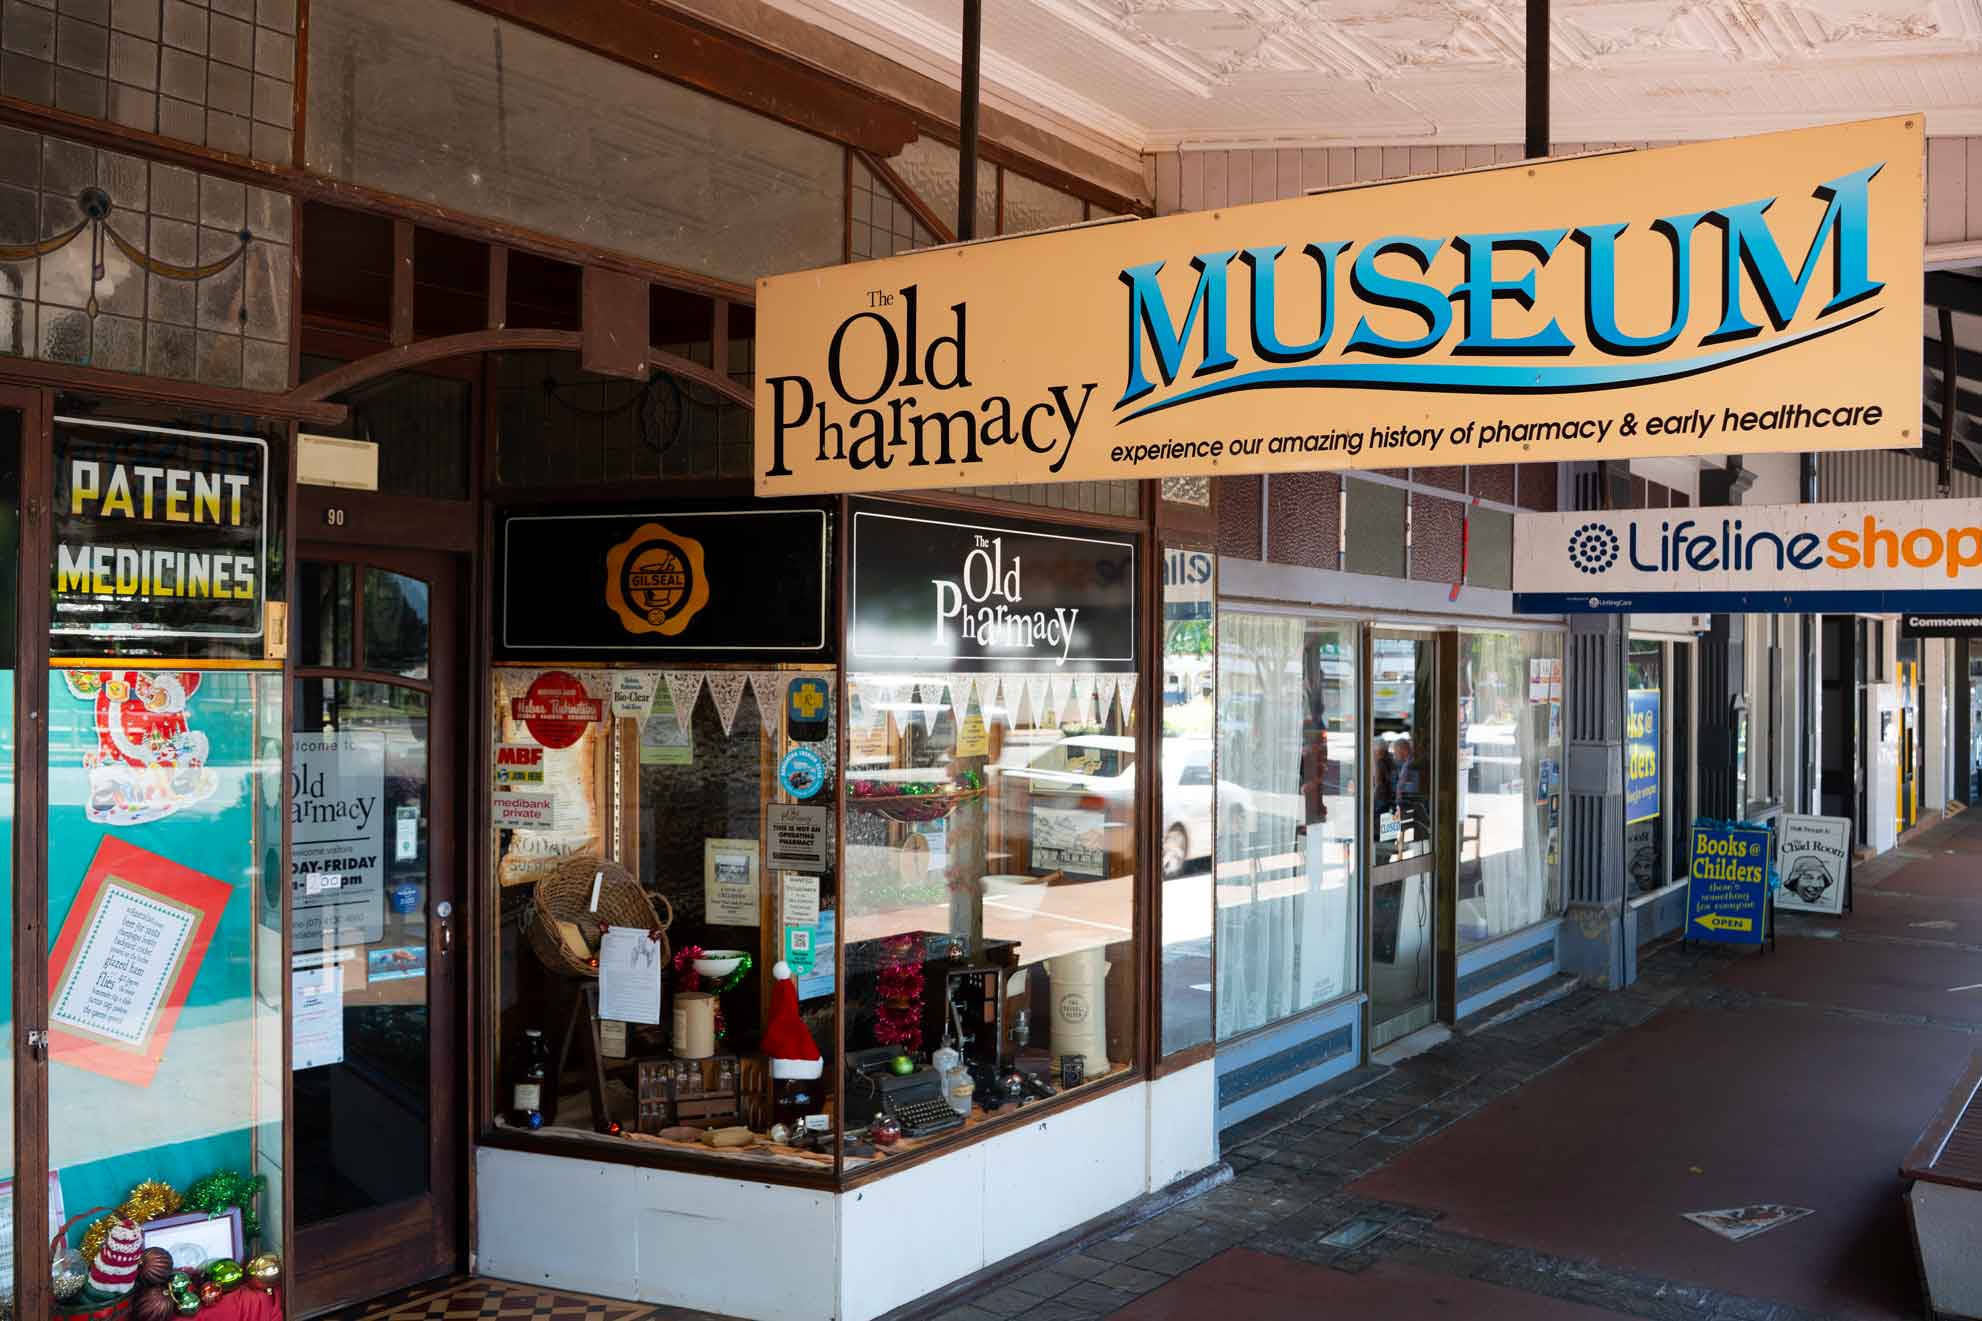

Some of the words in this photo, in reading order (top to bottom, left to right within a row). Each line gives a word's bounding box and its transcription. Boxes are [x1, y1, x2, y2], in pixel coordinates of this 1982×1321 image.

[867, 290, 894, 307] The
[1113, 162, 1886, 411] MUSEUM
[828, 284, 972, 404] Old
[765, 375, 1098, 477] Pharmacy
[1111, 438, 1222, 465] experience
[1229, 434, 1264, 456] our
[1268, 429, 1363, 456] amazing
[1369, 424, 1445, 452] history
[1450, 420, 1476, 446] of
[1479, 418, 1613, 449] pharmacy
[1619, 412, 1638, 436] &
[1645, 408, 1715, 438] early
[1721, 403, 1883, 432] healthcare
[71, 460, 250, 527] PATENT
[328, 509, 344, 526] 90
[974, 535, 989, 548] The
[57, 544, 255, 600] MEDICINES
[963, 537, 1023, 602] Old
[931, 579, 1079, 667] Pharmacy
[497, 747, 544, 766] MBF
[494, 799, 550, 809] medibank
[502, 808, 541, 819] private
[1696, 834, 1747, 857] Books
[1750, 843, 1761, 856] @
[1693, 857, 1762, 883] Childers
[1711, 918, 1744, 928] OPEN
